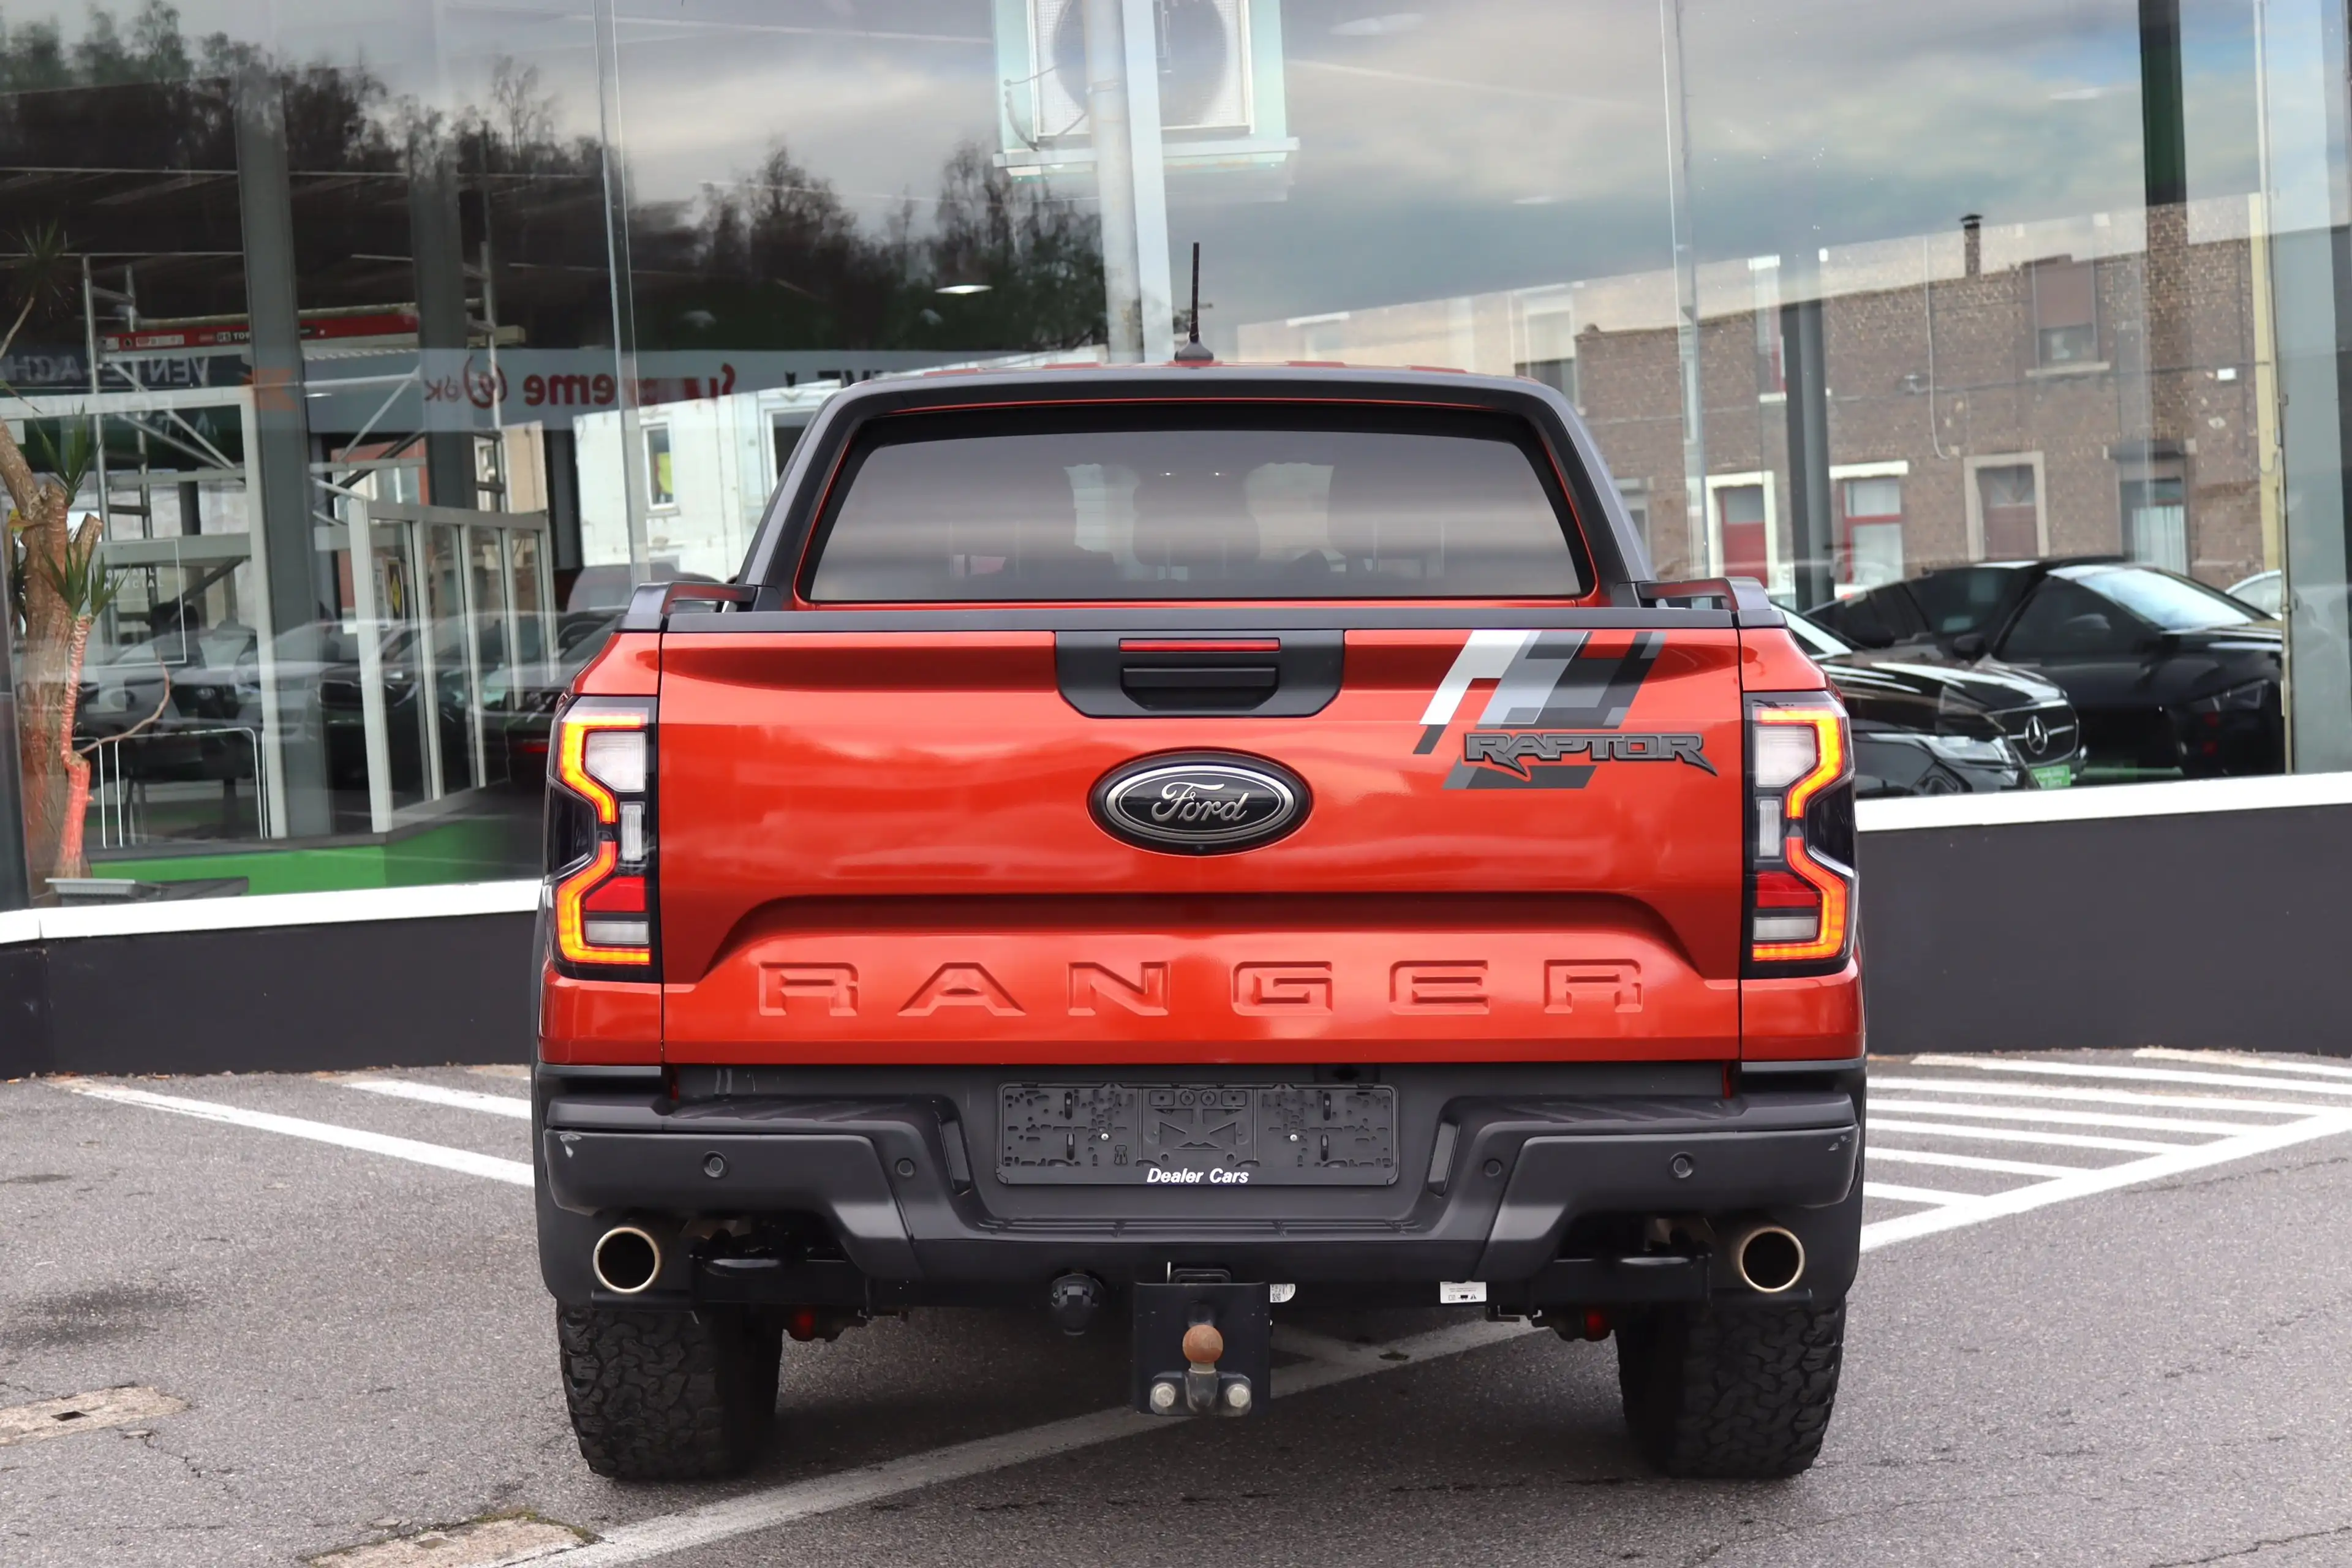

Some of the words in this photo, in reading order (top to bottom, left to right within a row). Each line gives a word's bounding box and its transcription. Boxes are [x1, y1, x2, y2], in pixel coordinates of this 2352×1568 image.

[1464, 732, 1718, 777] RAPTOR
[1151, 781, 1250, 823] Ford
[758, 959, 1644, 1016] RANGER
[1147, 1167, 1204, 1183] Dealer
[1209, 1167, 1250, 1183] Cars
